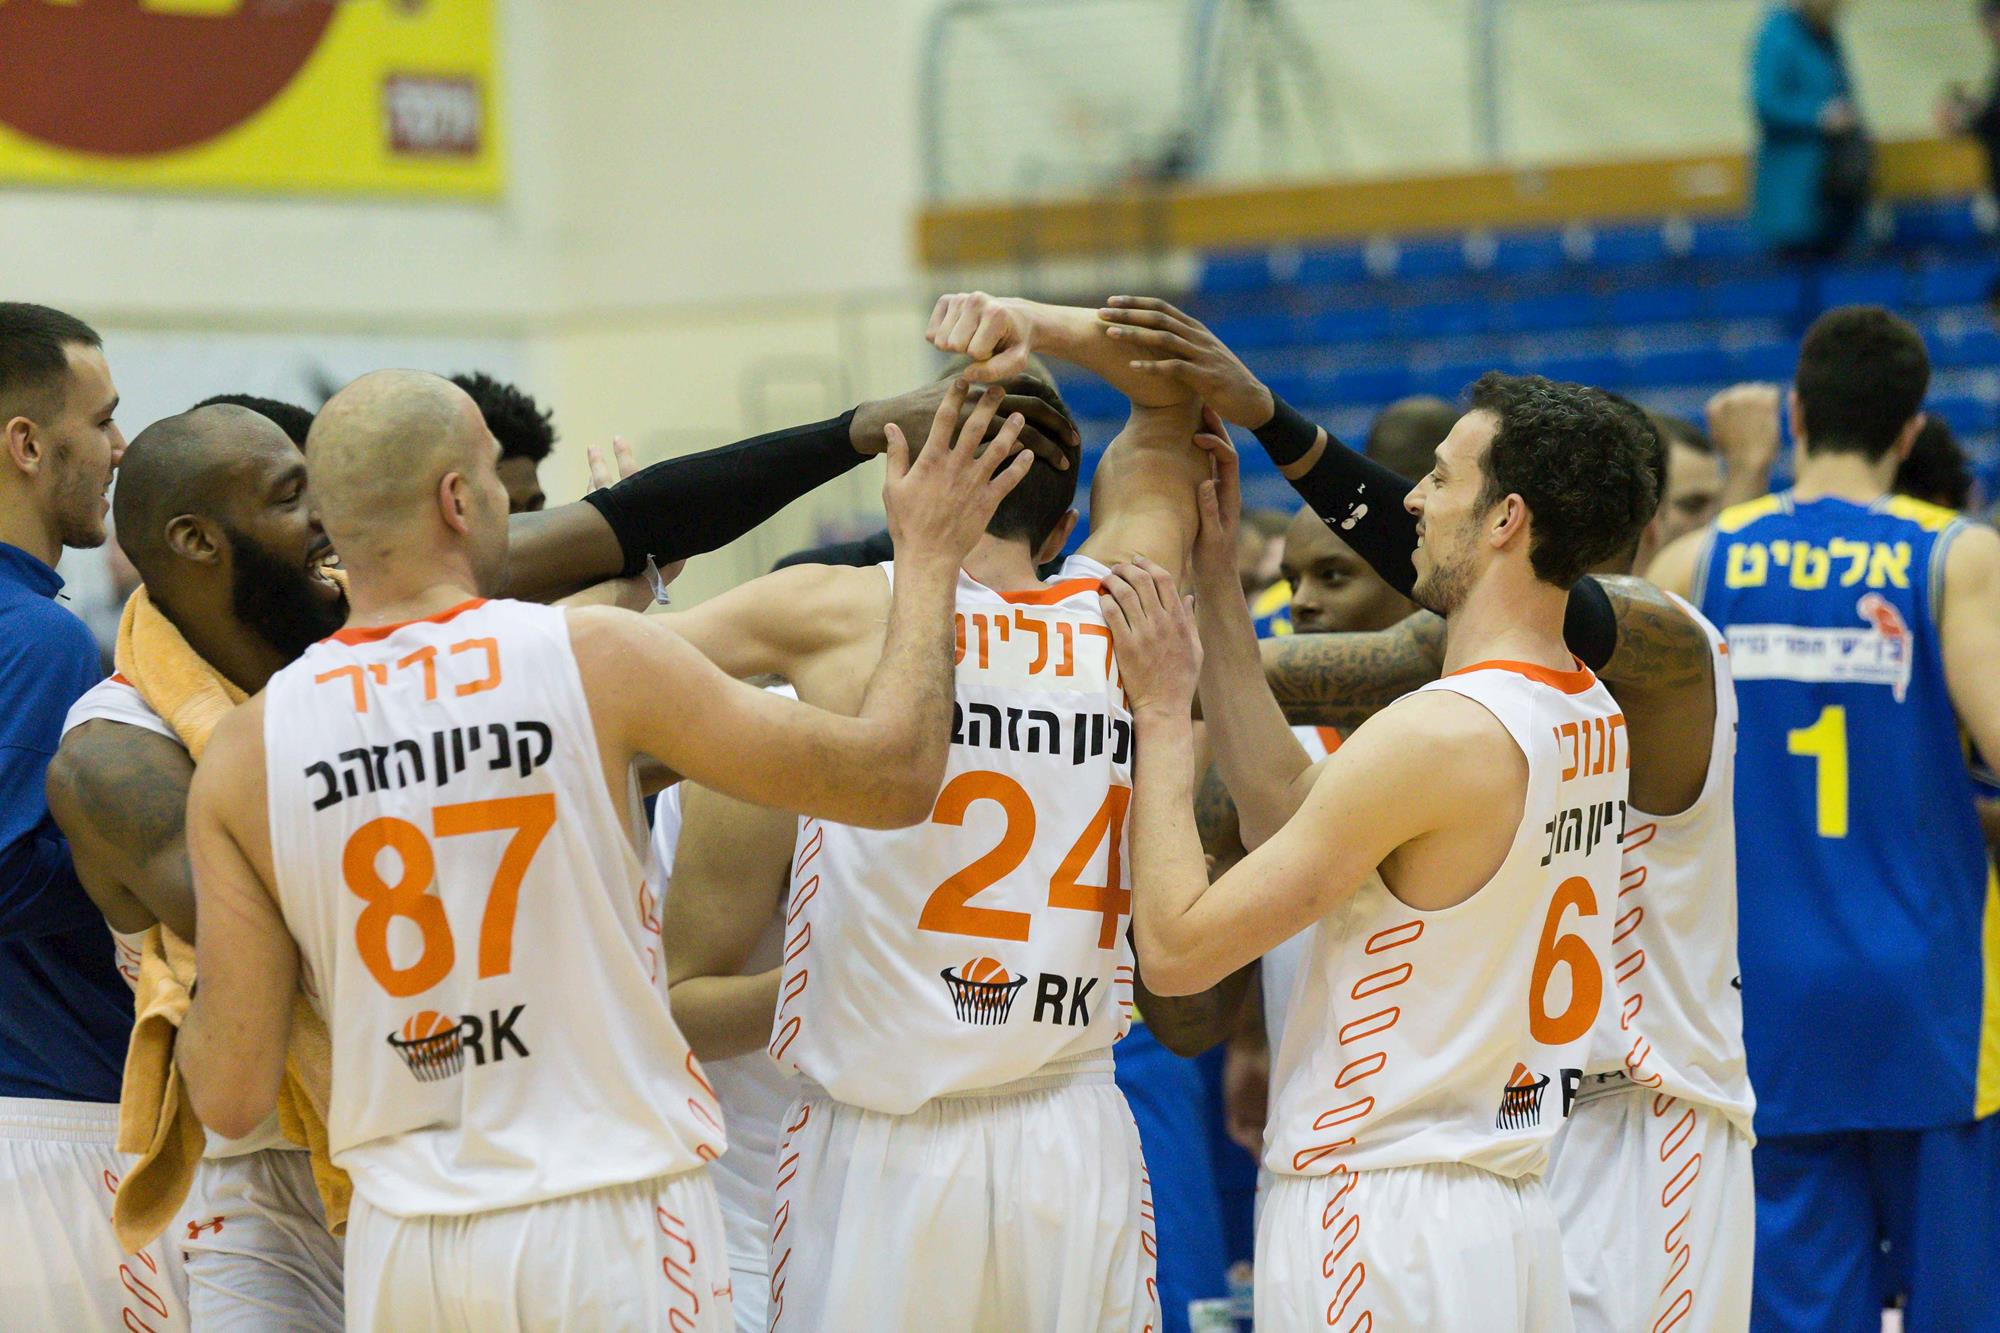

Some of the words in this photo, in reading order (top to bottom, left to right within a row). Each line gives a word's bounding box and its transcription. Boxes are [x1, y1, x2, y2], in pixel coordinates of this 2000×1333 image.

[314, 636, 503, 714] כדיר
[955, 608, 1128, 709] רנליו
[304, 738, 427, 812] הזהב
[432, 720, 553, 788] קניון
[1787, 704, 1849, 838] 1
[917, 769, 1132, 950] 24
[1585, 799, 1627, 858] ניון
[341, 792, 557, 998] 87
[1033, 972, 1098, 1027] RK
[1528, 875, 1602, 1046] 6
[458, 1003, 530, 1066] RK
